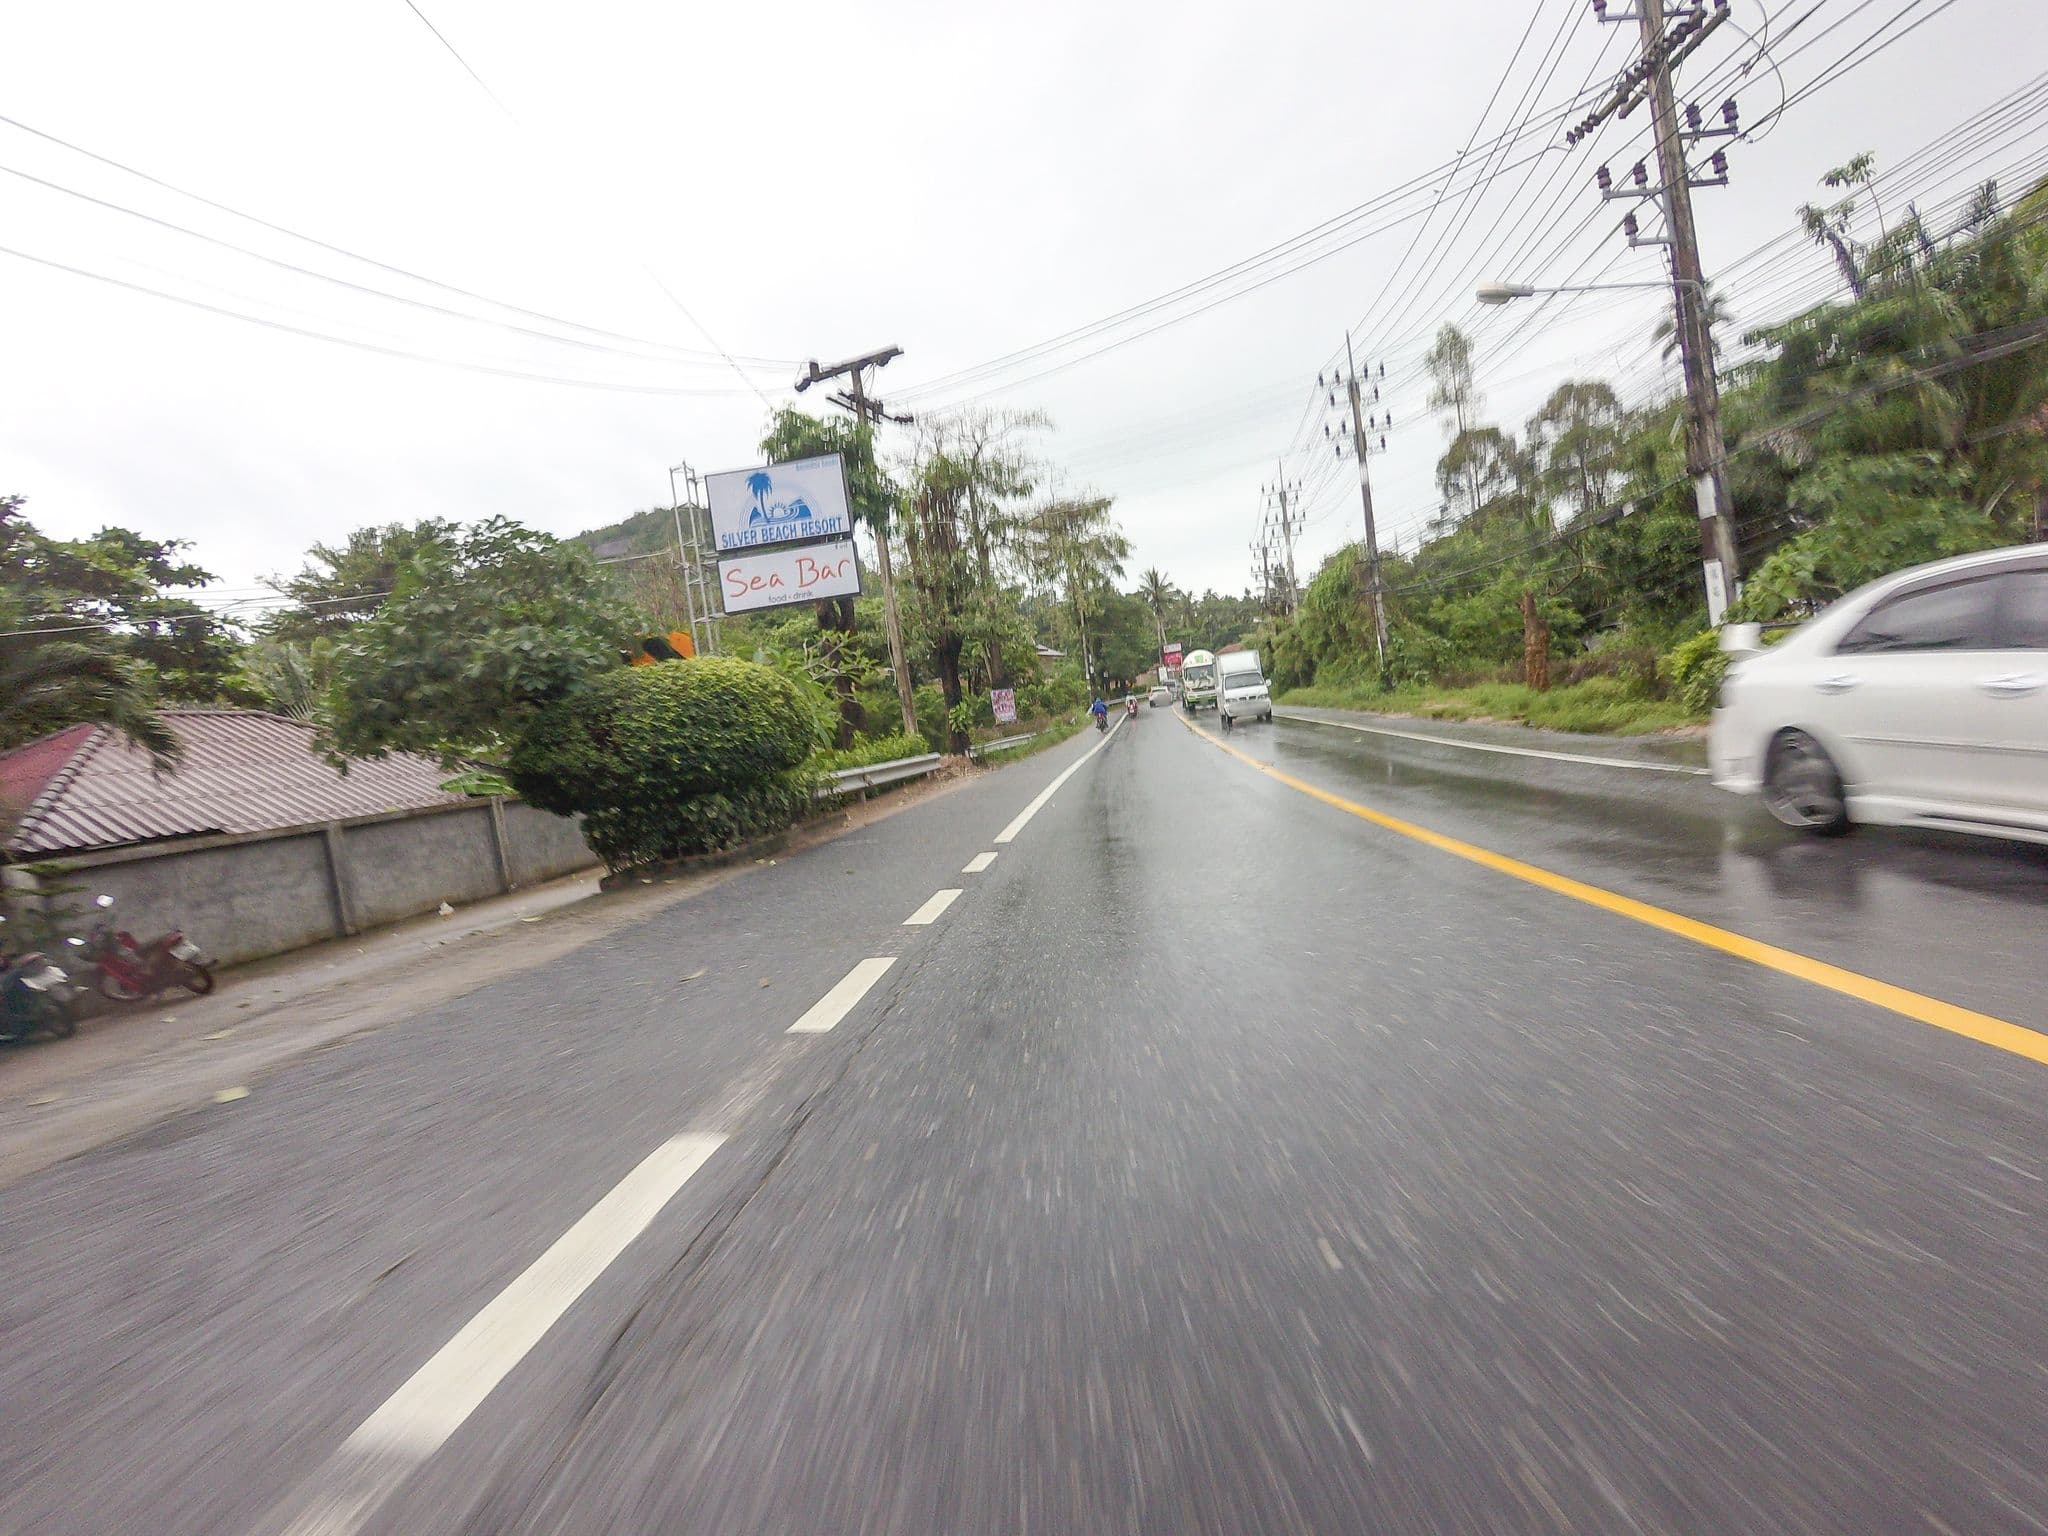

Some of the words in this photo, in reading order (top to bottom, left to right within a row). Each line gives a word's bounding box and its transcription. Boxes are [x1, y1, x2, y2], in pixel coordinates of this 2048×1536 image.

[722, 530, 757, 549] SILVER
[762, 524, 797, 542] BEACH
[801, 517, 843, 536] RESORT
[726, 568, 785, 598] Sea
[796, 557, 850, 588] Bar
[768, 594, 787, 604] food
[793, 590, 813, 600] drink
